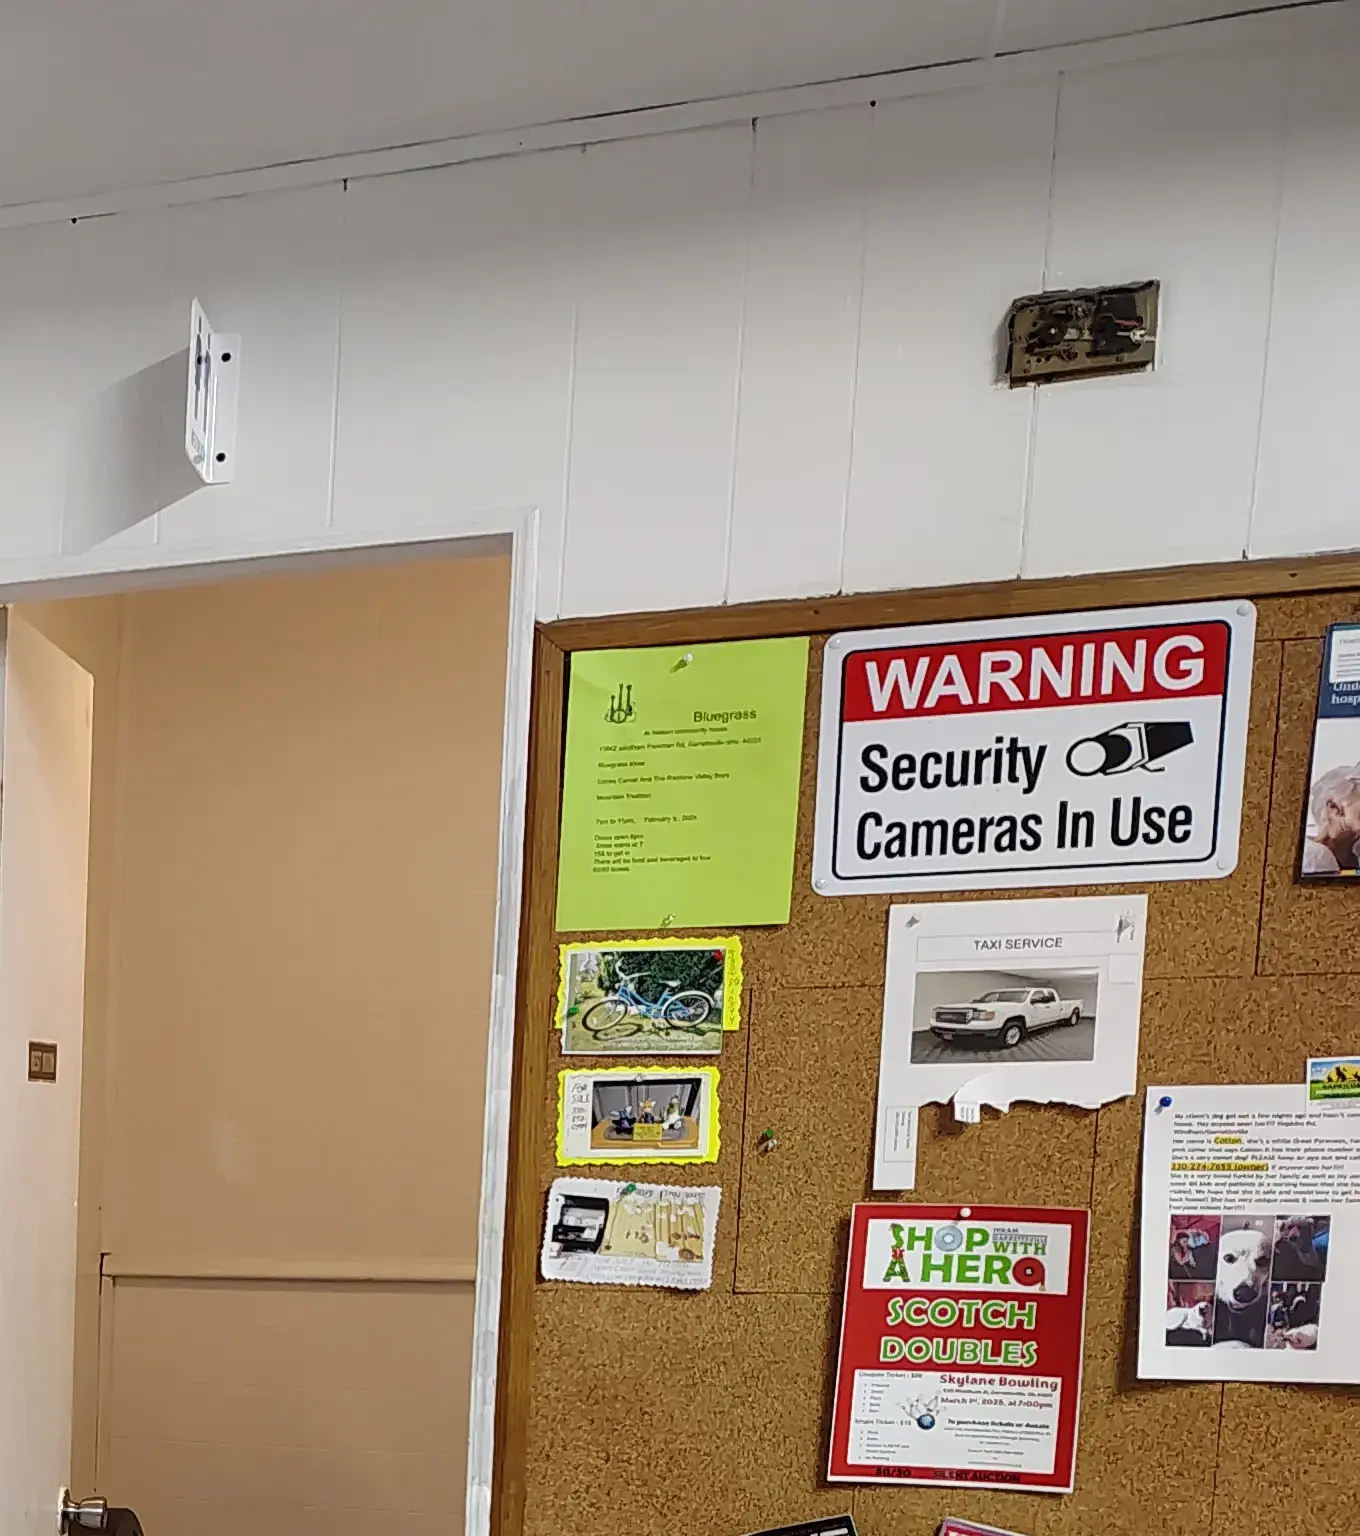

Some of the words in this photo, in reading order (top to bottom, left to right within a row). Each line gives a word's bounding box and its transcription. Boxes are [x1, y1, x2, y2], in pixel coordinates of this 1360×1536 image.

[865, 635, 1204, 713] WARNING
[693, 709, 757, 723] Bluegrass
[859, 736, 1048, 795] Security
[856, 809, 1043, 860] Cameras
[1057, 800, 1095, 849] In
[1110, 796, 1193, 847] Use
[974, 940, 1002, 951] TAXI
[1005, 937, 1063, 950] SERVICE
[889, 1223, 989, 1252] SHOP
[993, 1241, 1046, 1256] WITH
[883, 1257, 911, 1283] A
[920, 1253, 1047, 1291] HERO
[886, 1297, 1038, 1330] SCOTCH
[880, 1336, 1038, 1367] DOUBLES
[940, 1374, 996, 1387] Skylane
[999, 1376, 1058, 1392] Bowling
[941, 1396, 967, 1404] March
